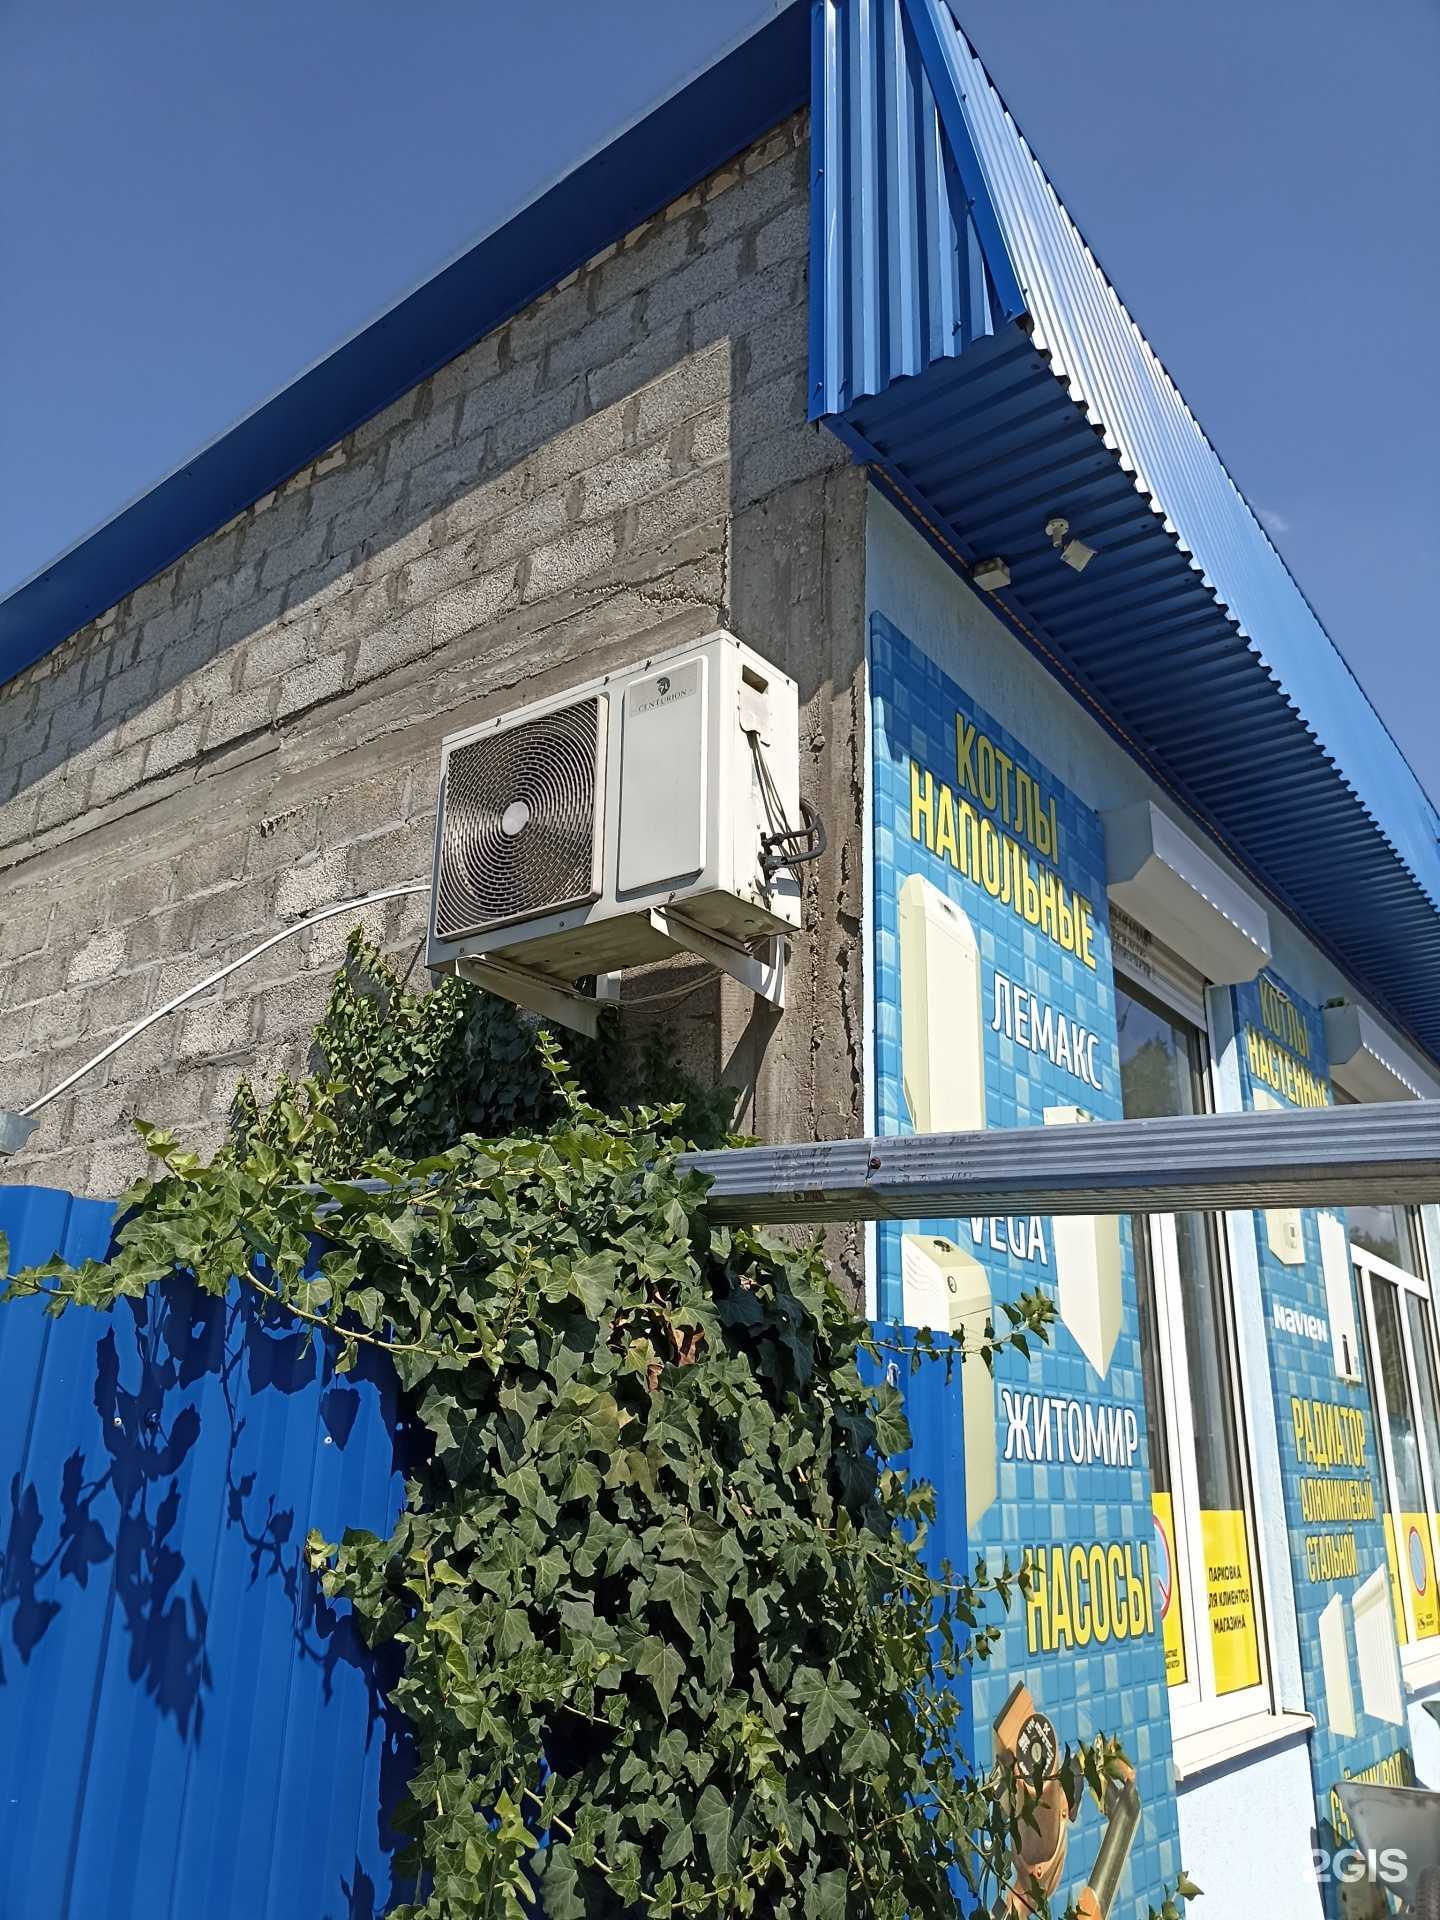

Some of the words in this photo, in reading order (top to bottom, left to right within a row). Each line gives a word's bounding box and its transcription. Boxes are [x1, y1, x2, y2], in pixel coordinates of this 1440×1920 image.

[638, 688, 688, 713] CENTURION
[955, 712, 1059, 865] КОТЛЫ
[910, 760, 1097, 971] НАПОЛЬНЫЕ
[991, 971, 1102, 1091] ЛЕМАКС
[1259, 979, 1310, 1060] КОТЛЫ
[1002, 1389, 1138, 1467] ЖИТОМИР
[1291, 1397, 1366, 1472] РАДИАТОР
[1300, 1473, 1376, 1522] АЛЮМИНИЕВЫЙ
[1208, 1565, 1242, 1581] ПАРКОВКА
[1306, 1526, 1358, 1583] СТАЛЬНОЙ
[1023, 1542, 1155, 1655] НАСОСЫ
[1213, 1614, 1246, 1634] МАГАЗИНА
[1219, 1588, 1250, 1607] КЛИЕНТОВ
